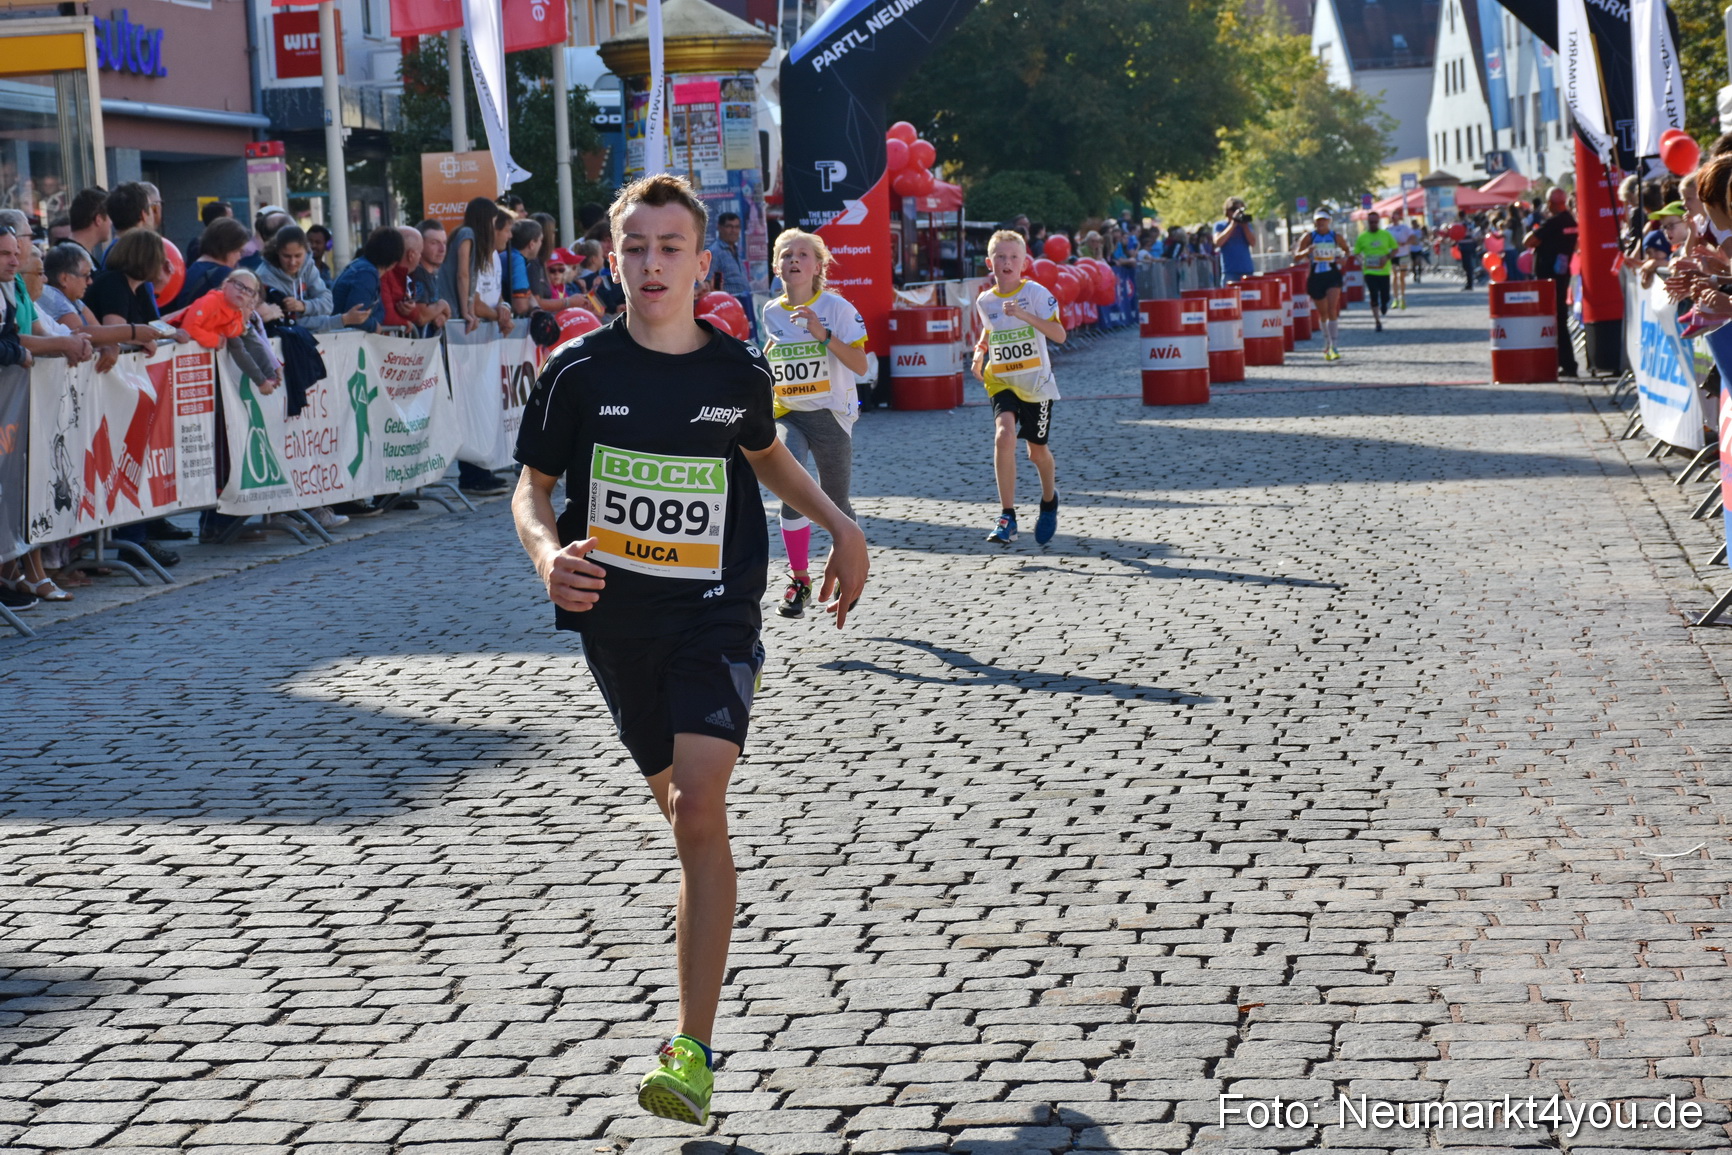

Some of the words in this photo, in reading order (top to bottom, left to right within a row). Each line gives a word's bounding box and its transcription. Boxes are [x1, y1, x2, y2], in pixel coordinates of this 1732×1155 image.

[811, 29, 869, 73] PARTL
[992, 328, 1030, 343] BOCK
[770, 343, 822, 360] BOCK
[994, 343, 1033, 361] 5008
[774, 361, 820, 382] 5007
[1006, 363, 1024, 371] LUIS
[782, 385, 817, 395] SOPHIA
[598, 405, 630, 416] JAKO
[602, 451, 717, 490] BOCK
[603, 489, 710, 536] 5089
[624, 540, 679, 562] LUCA
[702, 584, 725, 598] 49
